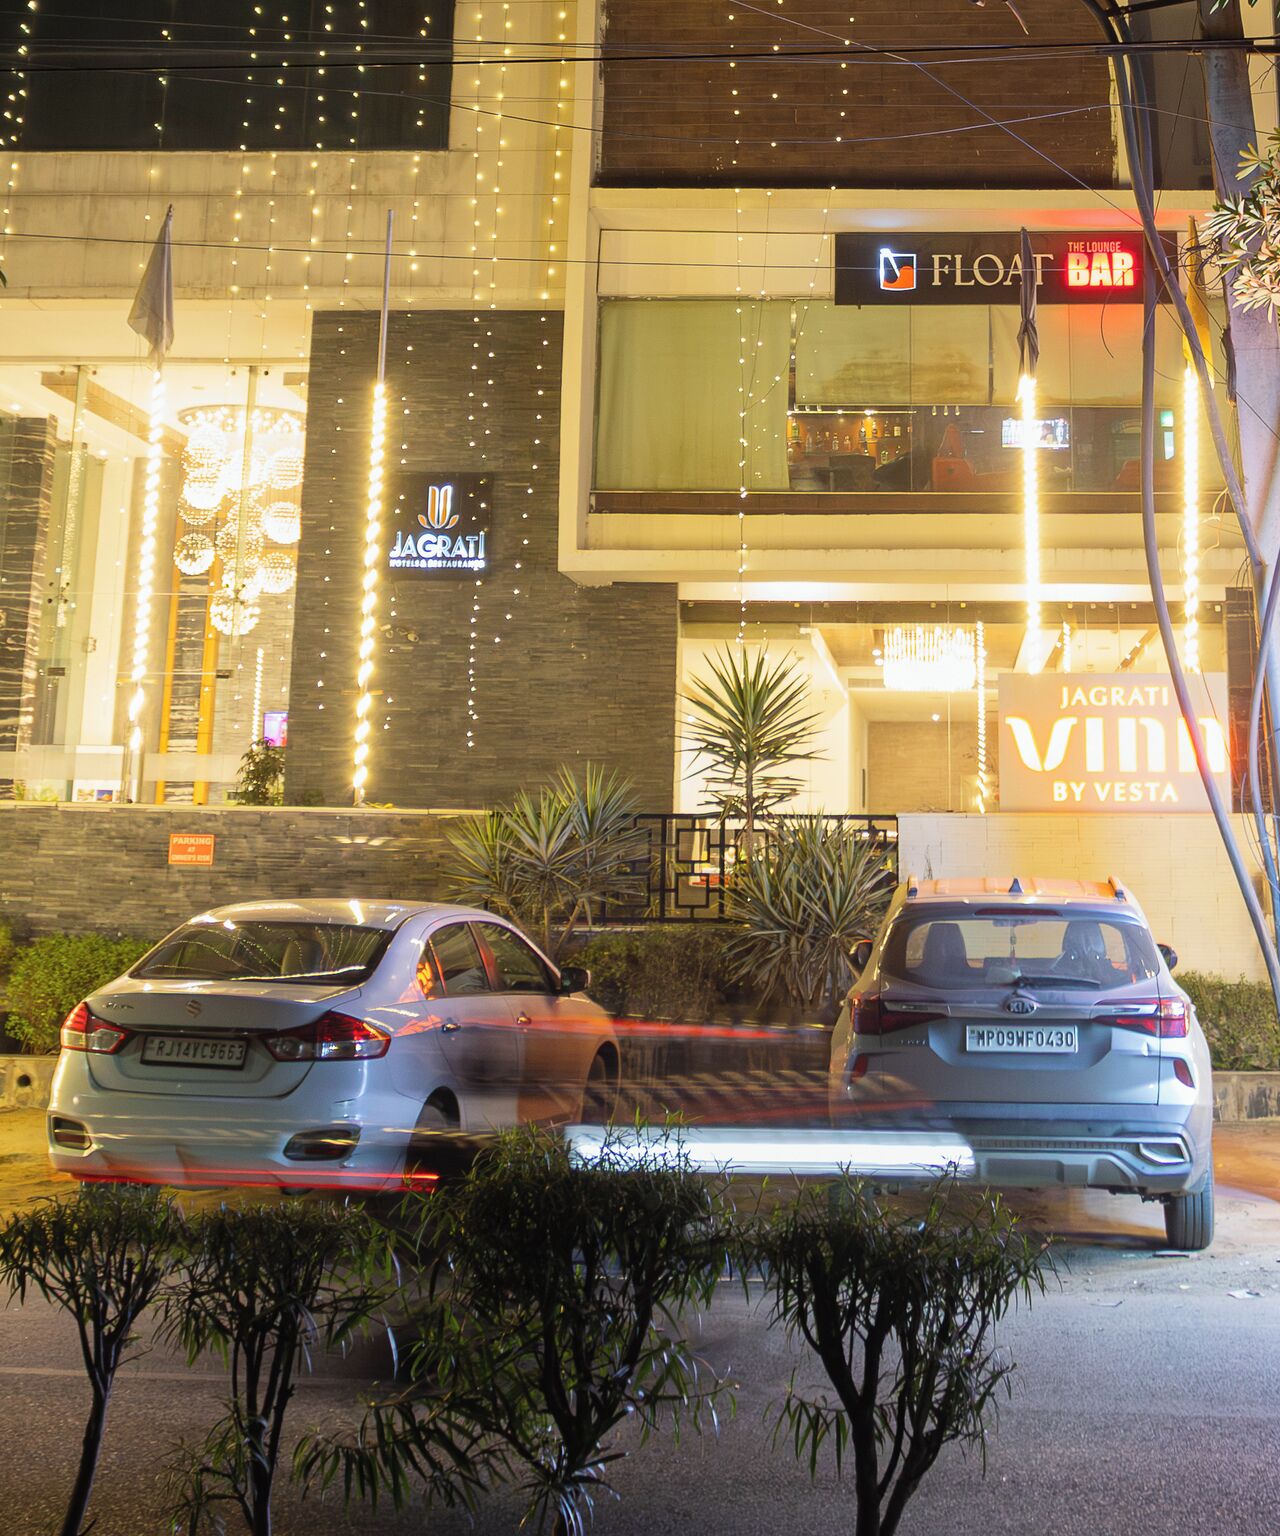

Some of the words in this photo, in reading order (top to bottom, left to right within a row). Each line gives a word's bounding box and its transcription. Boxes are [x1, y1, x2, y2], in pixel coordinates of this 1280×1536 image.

[1067, 241, 1085, 253] THE
[1086, 241, 1121, 253] LOUNGE
[931, 253, 1054, 286] FLOAT
[1067, 252, 1134, 287] BAR
[389, 531, 485, 558] JAGRATI
[1060, 686, 1168, 709] JAGRATI
[1053, 782, 1086, 802] BY
[1094, 782, 1179, 803] VESTA
[173, 837, 212, 845] PARKING
[976, 1031, 1075, 1047] MP09WF0430
